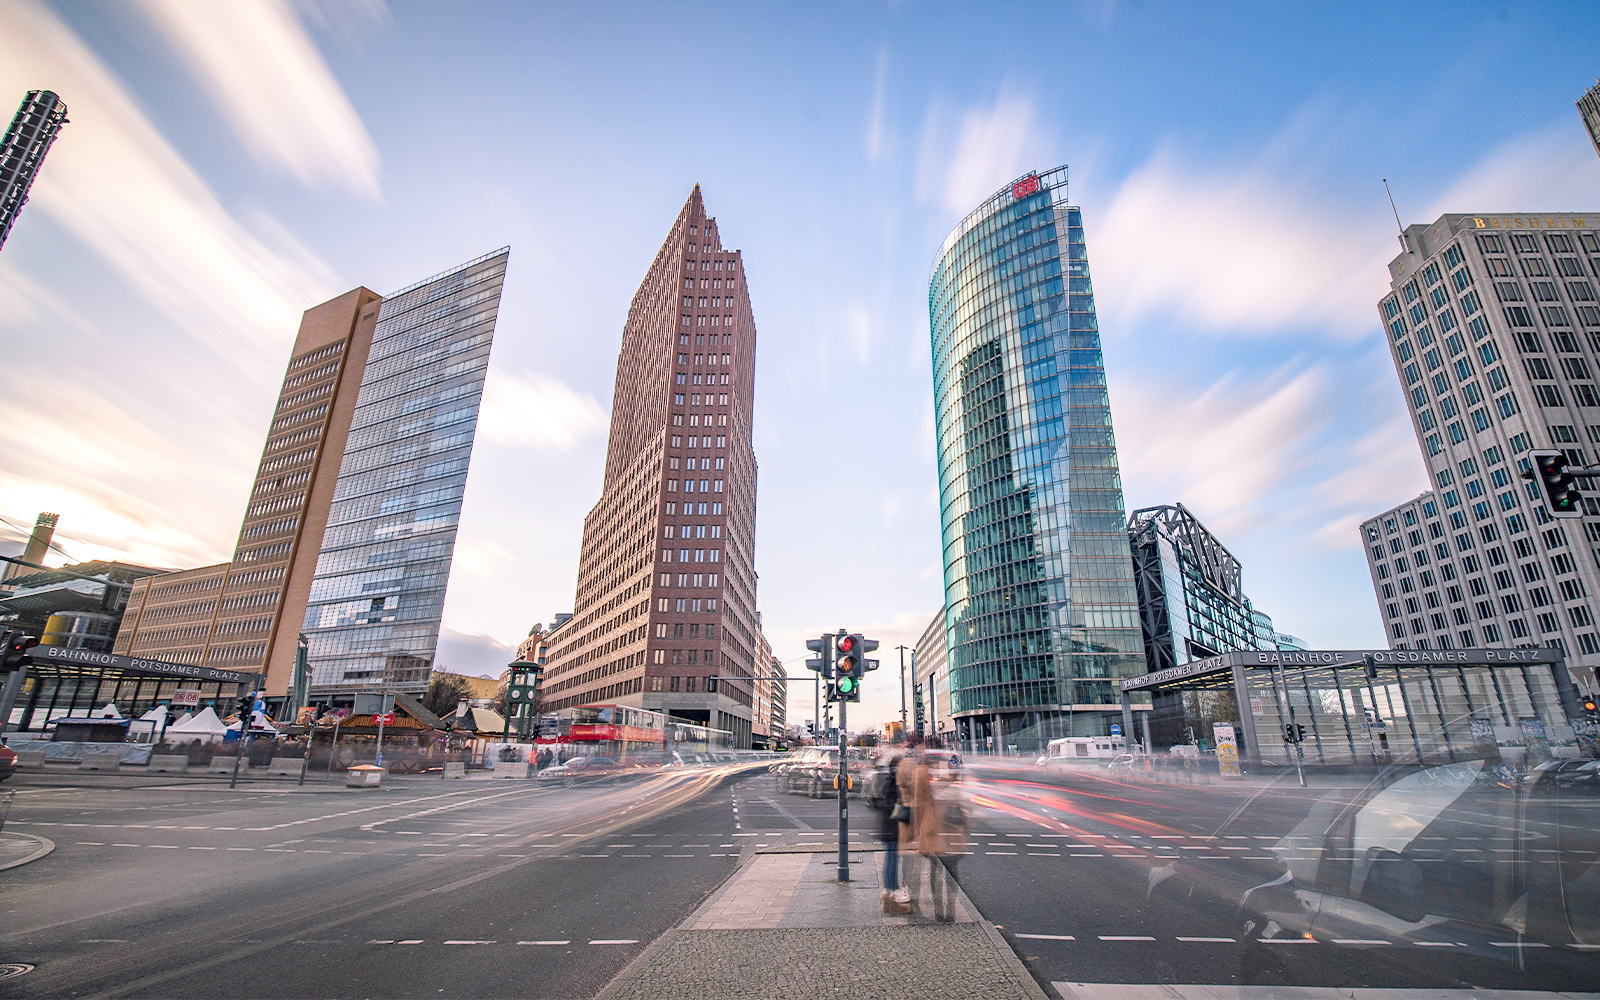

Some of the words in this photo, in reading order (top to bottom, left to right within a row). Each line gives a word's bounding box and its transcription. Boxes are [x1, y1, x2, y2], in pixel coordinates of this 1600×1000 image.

[1015, 177, 1037, 197] DB
[1472, 217, 1588, 229] BEISHEIM
[1258, 652, 1344, 663] BAHNHOF
[1486, 650, 1541, 661] PLATZ
[48, 647, 119, 665] BAHNHOF
[130, 659, 200, 676] POTSDAMER
[209, 668, 240, 681] PLATZ
[1123, 675, 1150, 688] BAHNHOF
[1153, 665, 1192, 682] POTSDAMER
[1197, 656, 1224, 671] PLATZ
[174, 693, 185, 701] DB
[187, 693, 198, 701] DB
